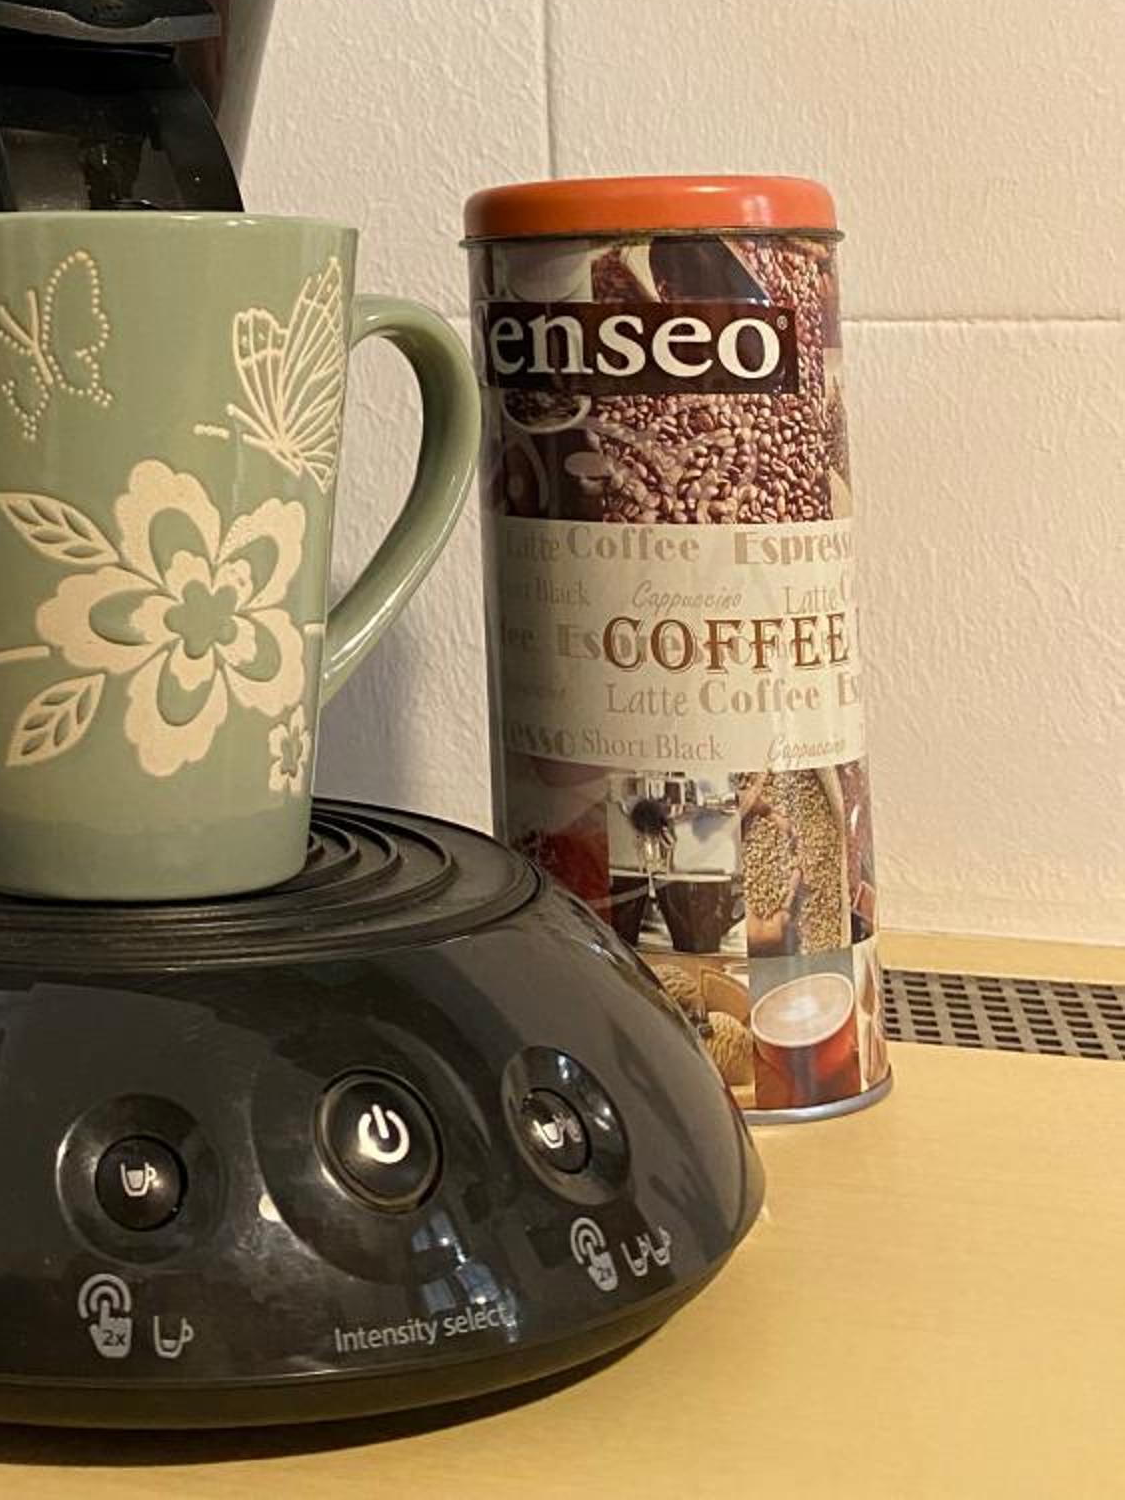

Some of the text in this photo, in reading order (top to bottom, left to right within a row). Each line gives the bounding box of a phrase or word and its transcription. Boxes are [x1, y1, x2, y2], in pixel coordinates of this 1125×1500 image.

[566, 525, 700, 563] Coffee
[603, 613, 849, 673] COFFEE
[606, 683, 688, 716] Latte
[699, 678, 820, 714] Coffee
[581, 726, 647, 758] Short
[655, 733, 725, 762] Black
[334, 1305, 508, 1351] Intensity select
